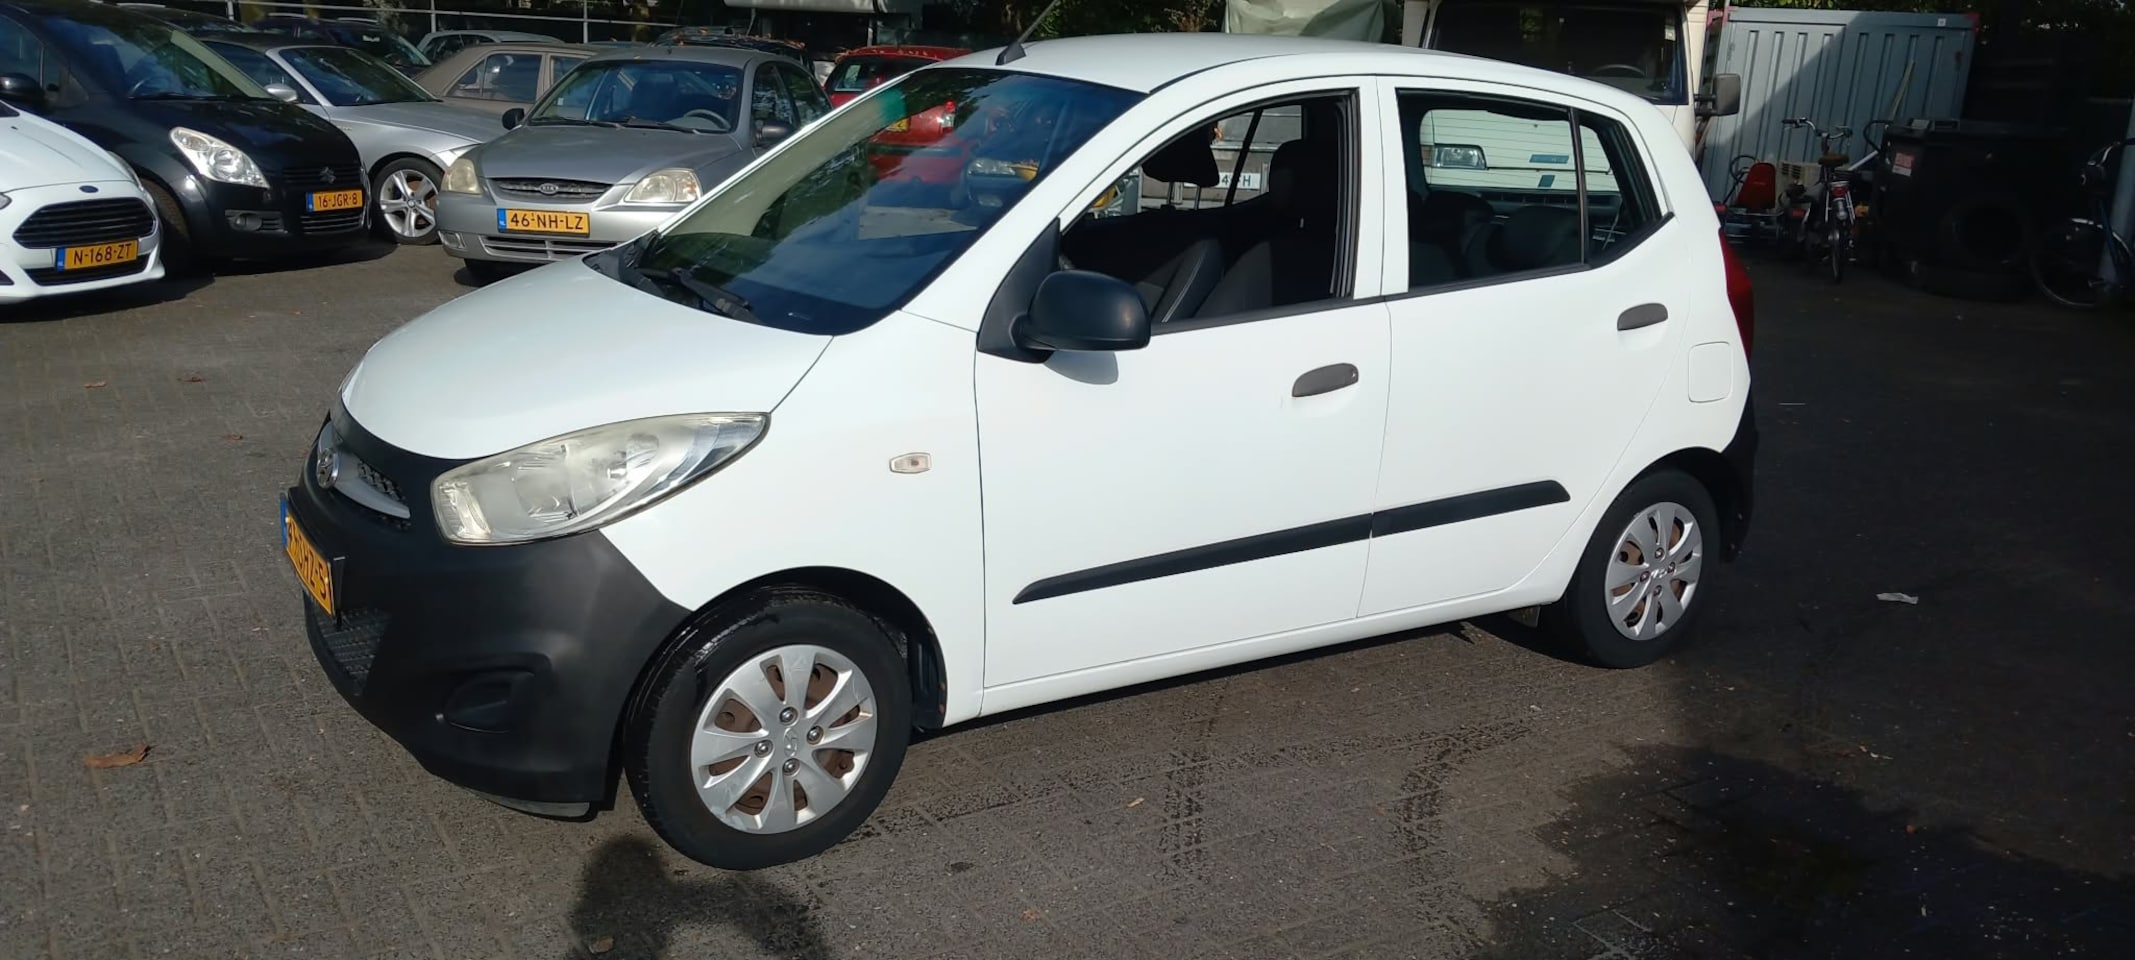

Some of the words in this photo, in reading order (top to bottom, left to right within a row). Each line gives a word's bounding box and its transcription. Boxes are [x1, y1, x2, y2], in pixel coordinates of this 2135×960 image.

[319, 193, 358, 208] 16-JGR-8
[511, 213, 583, 230] 46-NH-LZ
[73, 243, 132, 265] N-168-ZT
